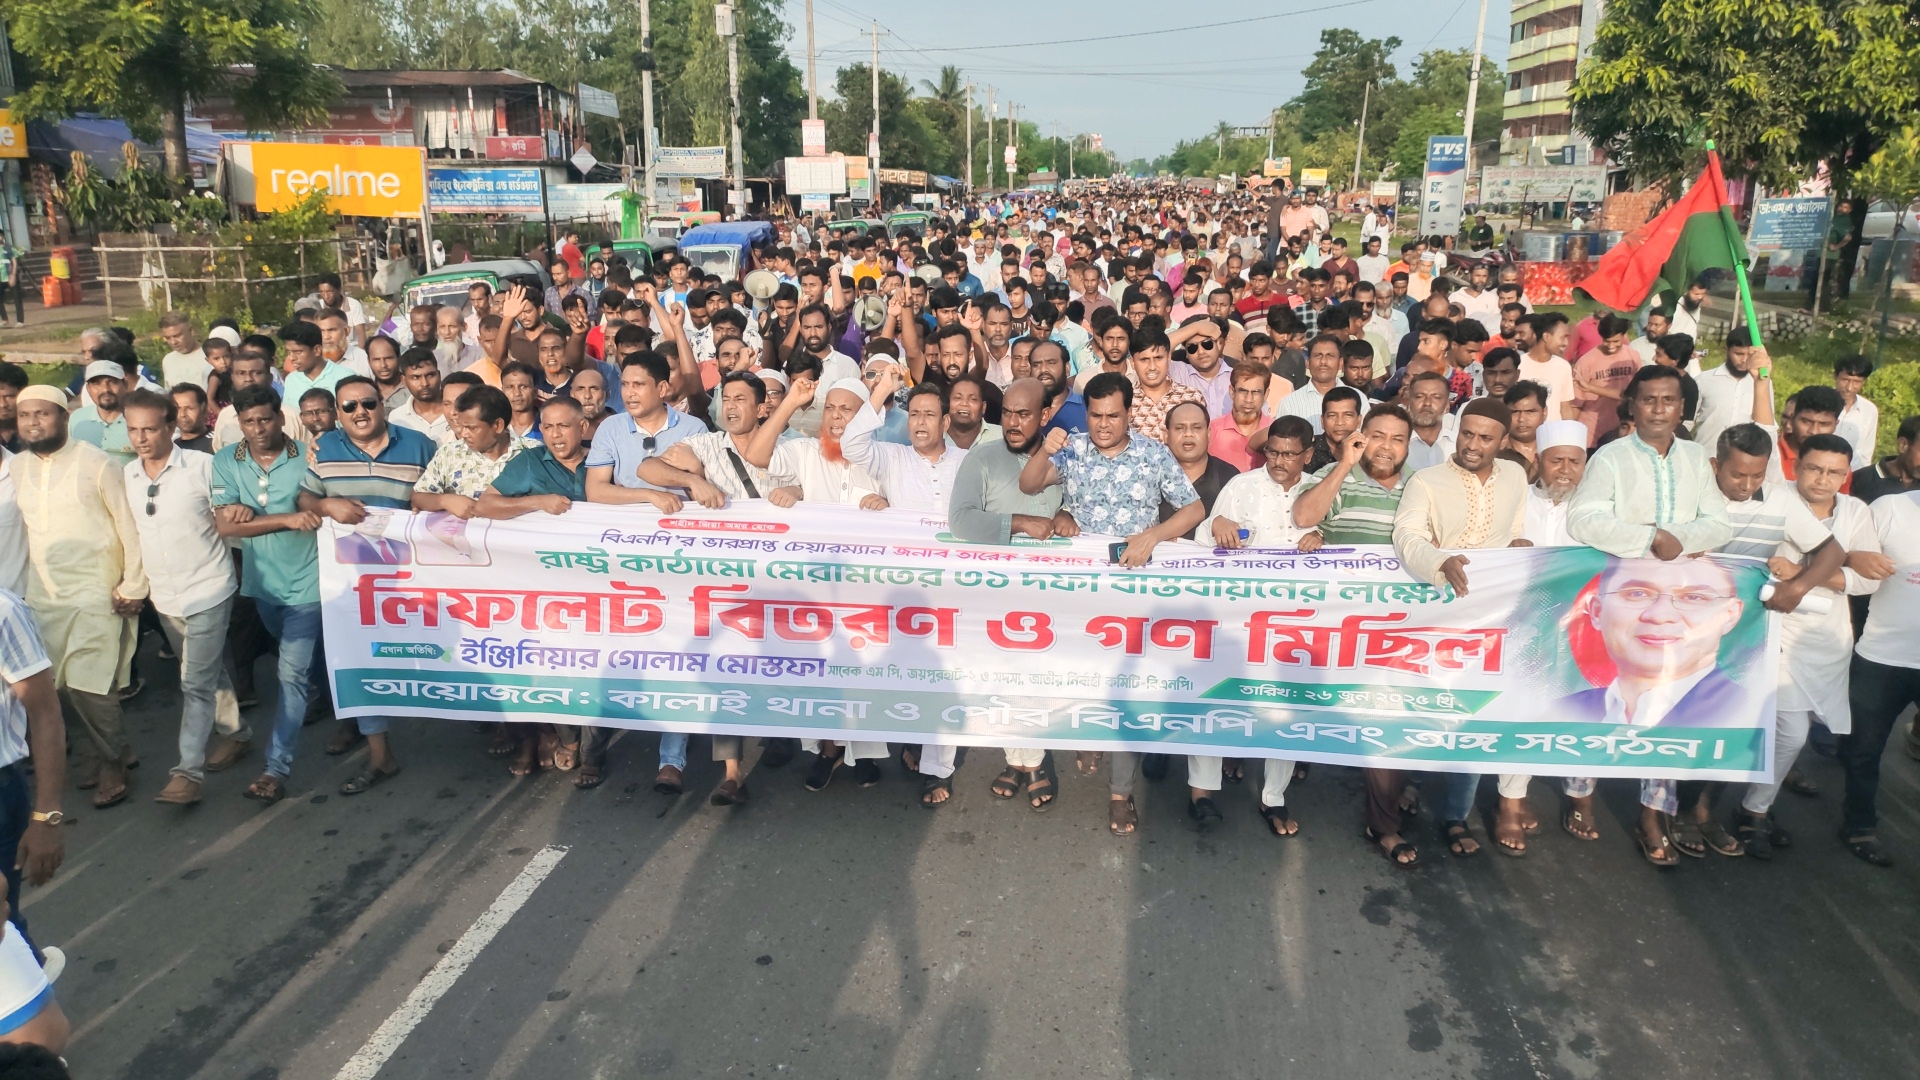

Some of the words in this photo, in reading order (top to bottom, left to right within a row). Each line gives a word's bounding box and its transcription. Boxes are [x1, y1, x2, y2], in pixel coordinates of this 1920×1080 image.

[1433, 143, 1464, 155] TVS
[271, 164, 401, 198] realme
[669, 519, 695, 528] শহীদ
[698, 520, 721, 529] জিয়া
[724, 521, 749, 530] অমর
[751, 522, 776, 531] হোক
[702, 536, 779, 552] ভারপ্রাপ্ত
[784, 541, 887, 556] চেয়ারম্যান
[893, 546, 950, 558] জনাব
[956, 549, 1019, 562] তারেক
[1231, 558, 1296, 570] সামনে
[535, 546, 610, 574] রাষ্ট্র
[616, 548, 757, 578] কাঠামো
[766, 560, 946, 588] মেরামতের
[954, 569, 1010, 589] ৩১
[1020, 571, 1101, 592] দফা
[1109, 573, 1330, 604] বাস্তবায়নের
[353, 571, 667, 633] লিফলেট
[688, 583, 960, 649] বিতরণ
[986, 611, 1055, 651] ও
[1084, 614, 1219, 660] গণ
[1244, 609, 1509, 676] মিছিল
[379, 645, 403, 656] প্রধান
[460, 637, 600, 670] ইঞ্জিনিয়ার
[607, 648, 710, 673] গোলাম
[717, 653, 826, 678] মোস্তফা
[828, 665, 862, 677] সাবেক
[866, 666, 884, 677] এম
[1304, 689, 1332, 701] ২৬
[1337, 689, 1370, 705] জুন
[1375, 692, 1429, 706] ২০২৫
[607, 689, 752, 716] কালাই
[766, 696, 872, 719] থানা
[884, 702, 921, 721] ও
[941, 695, 1054, 728] পৌর
[1068, 704, 1257, 737] বিএনপি
[1275, 721, 1387, 749] এবং
[1402, 728, 1503, 753] অঙ্গ
